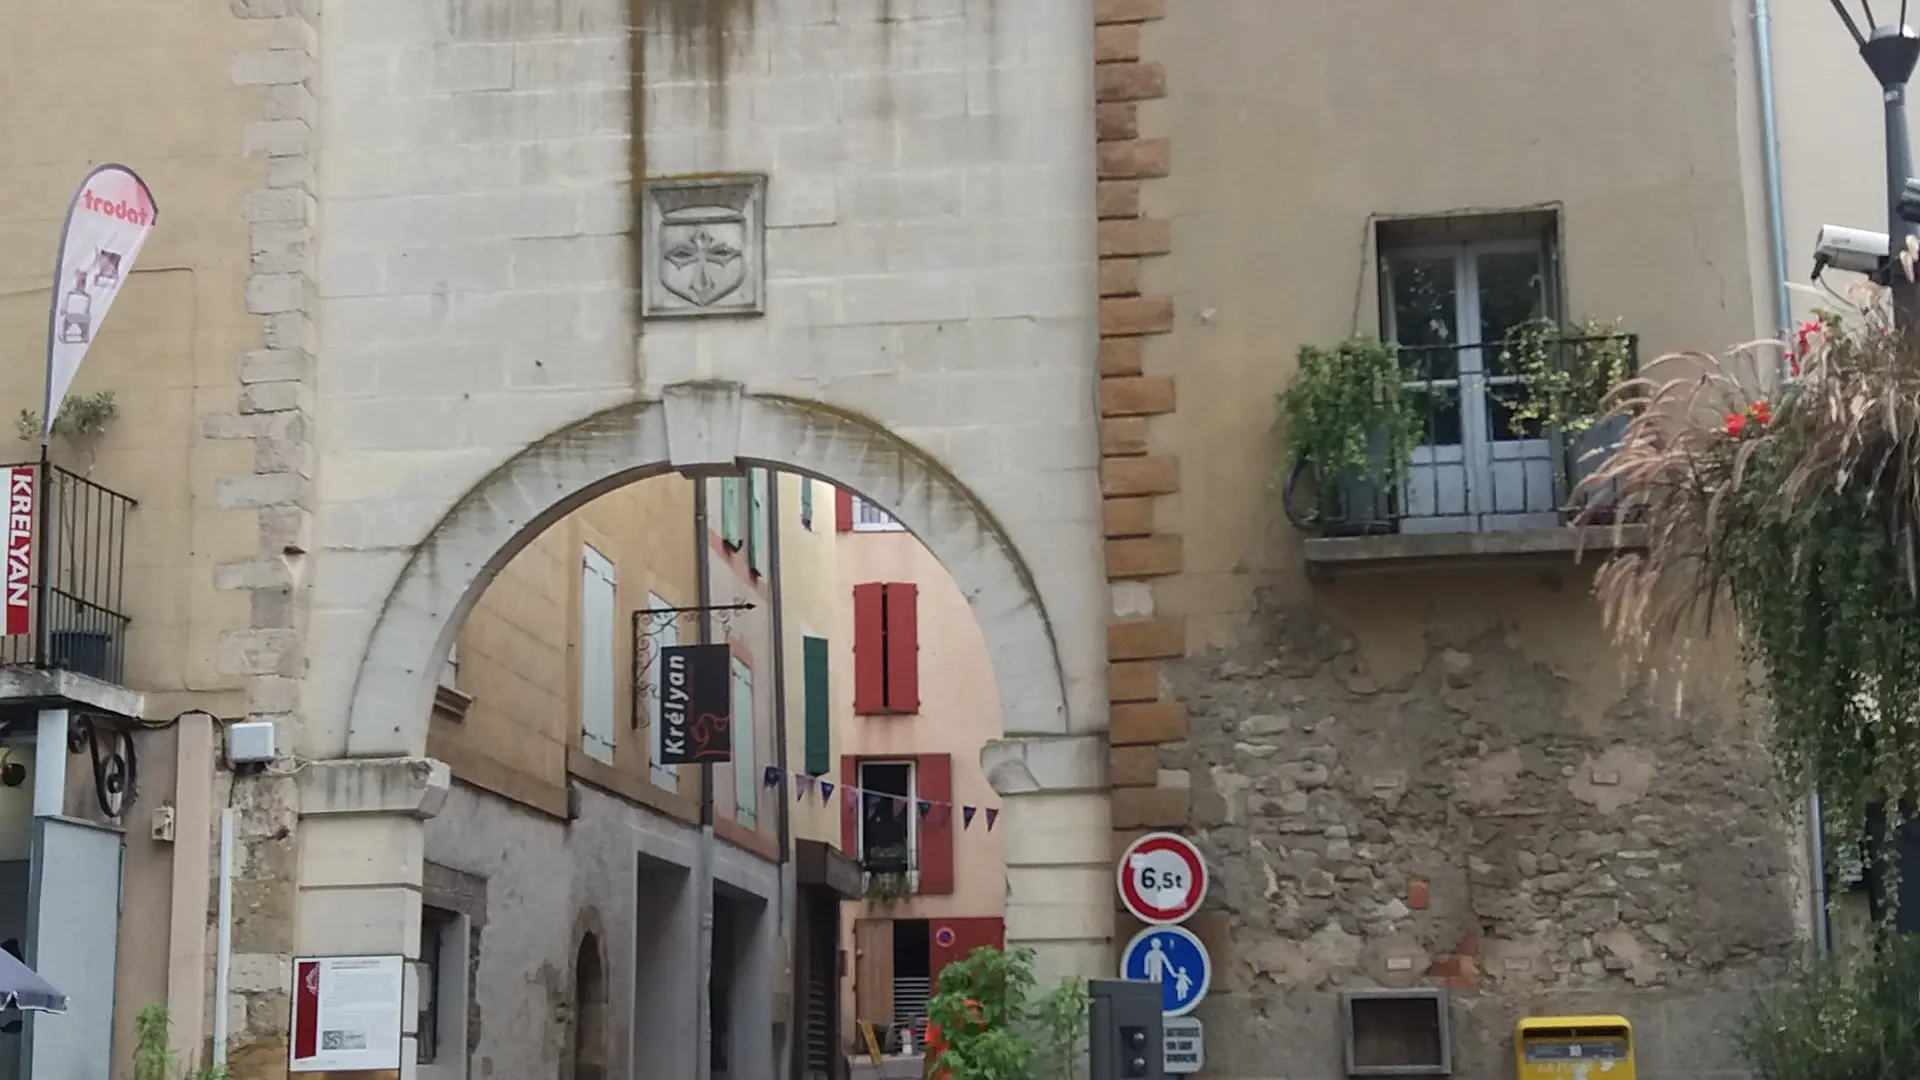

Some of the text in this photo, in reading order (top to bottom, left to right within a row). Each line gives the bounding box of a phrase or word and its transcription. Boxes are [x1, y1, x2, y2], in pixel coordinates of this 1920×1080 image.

[84, 189, 149, 227] trodat
[8, 474, 32, 607] KRELYAN
[664, 655, 690, 755] Krélyan
[1141, 867, 1183, 892] 6,5t
